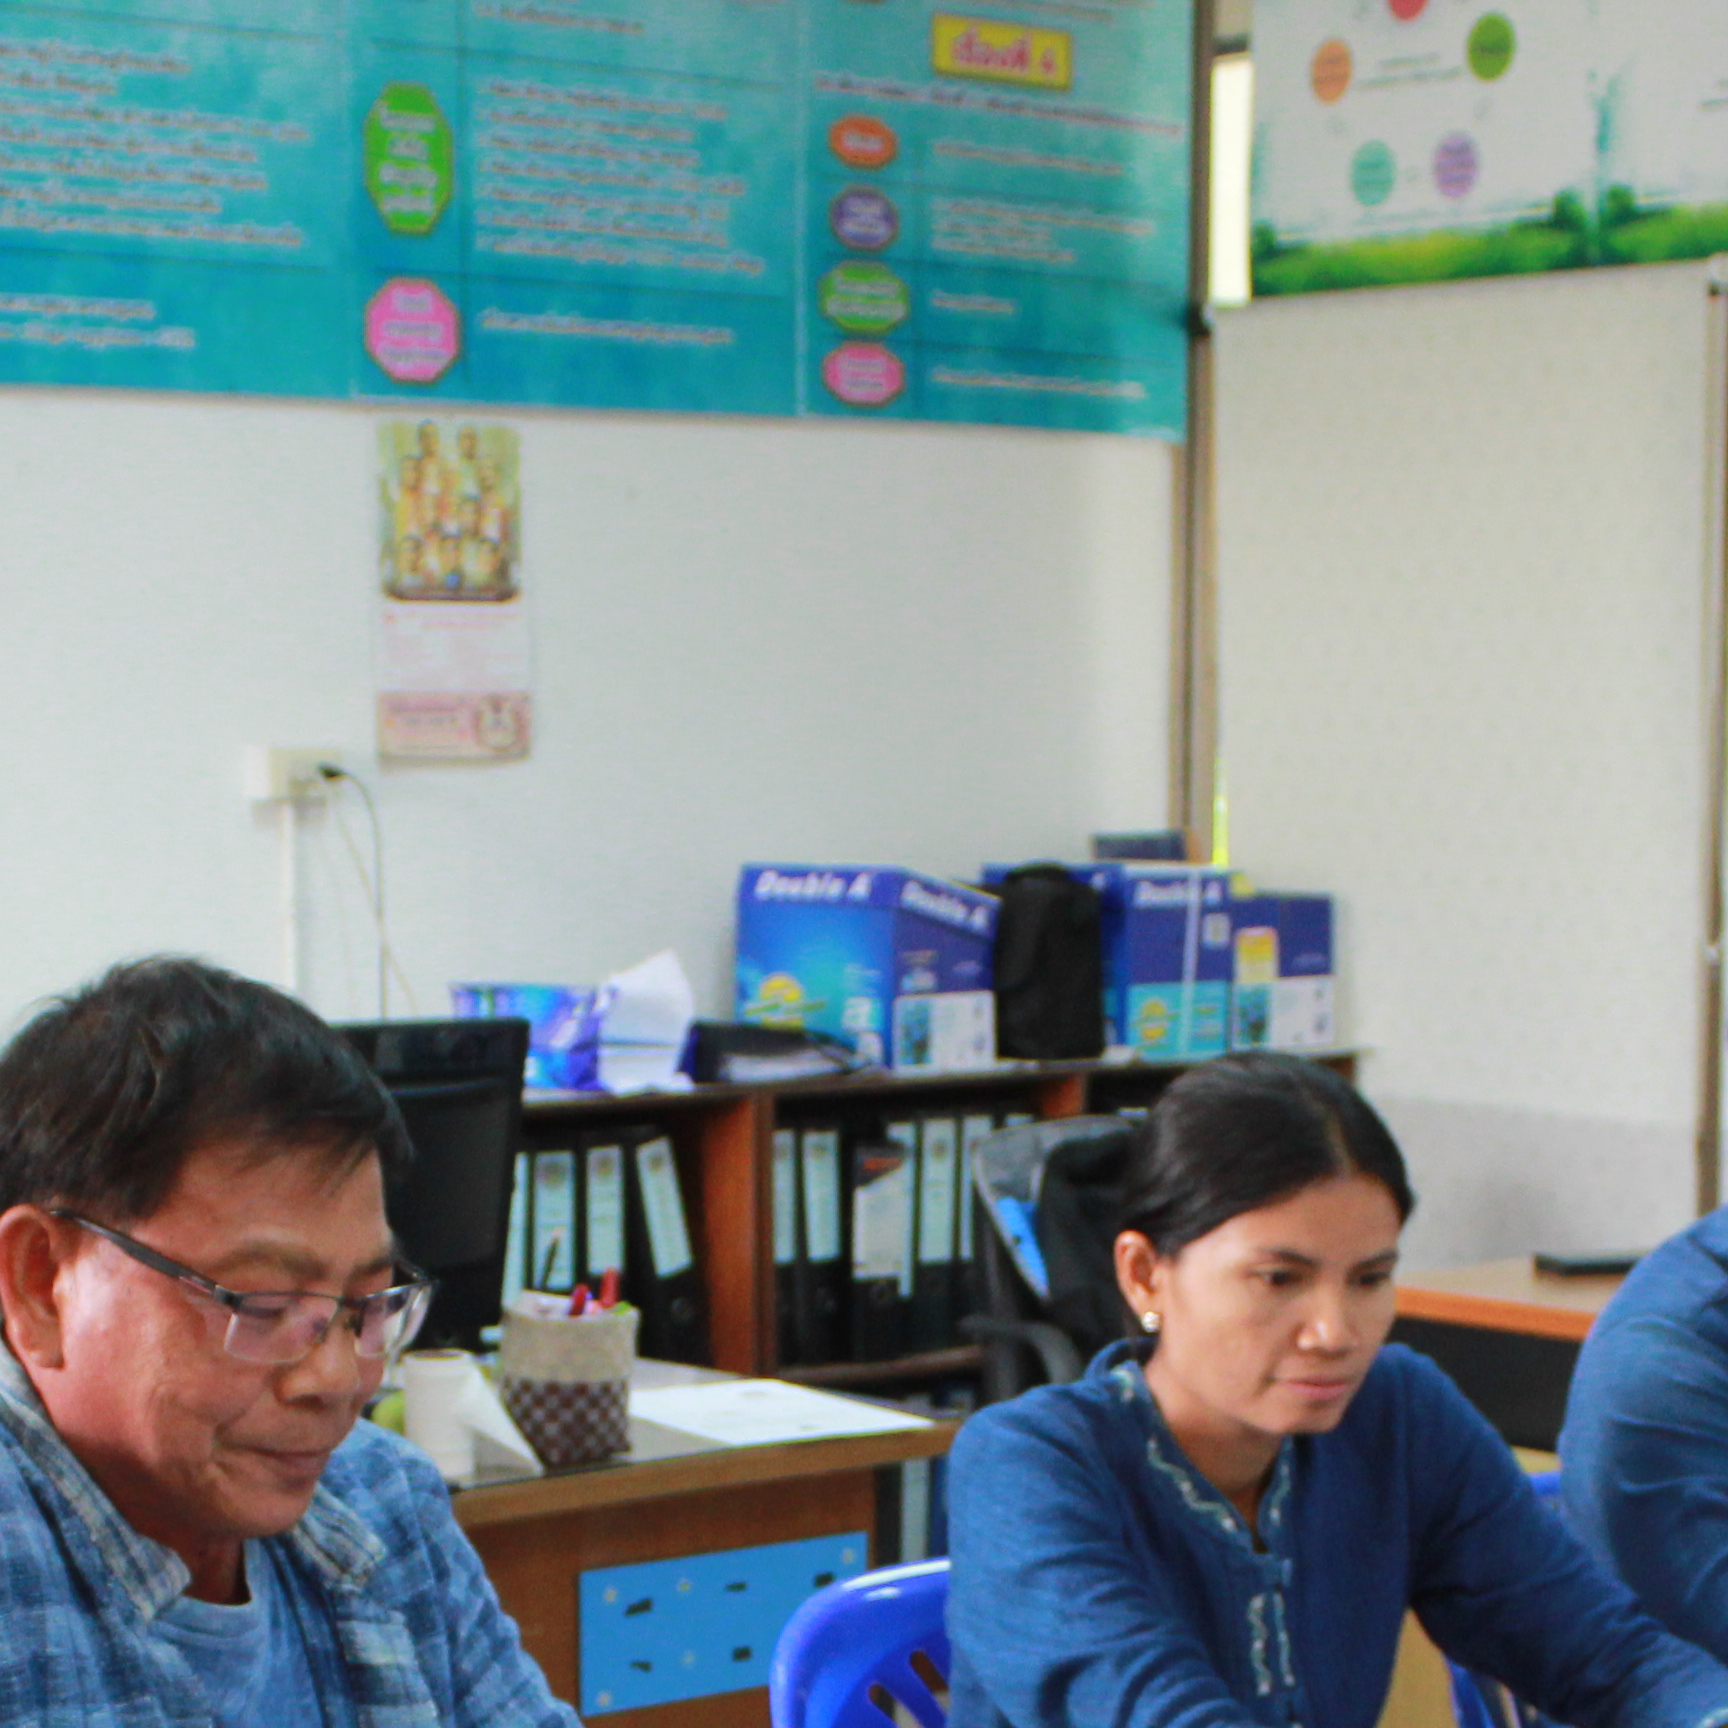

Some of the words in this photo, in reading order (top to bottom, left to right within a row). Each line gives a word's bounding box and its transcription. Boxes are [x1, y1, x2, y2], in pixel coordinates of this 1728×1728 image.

[755, 870, 846, 901] Double
[847, 871, 872, 901] A
[899, 880, 970, 925] Double
[970, 904, 990, 931] A
